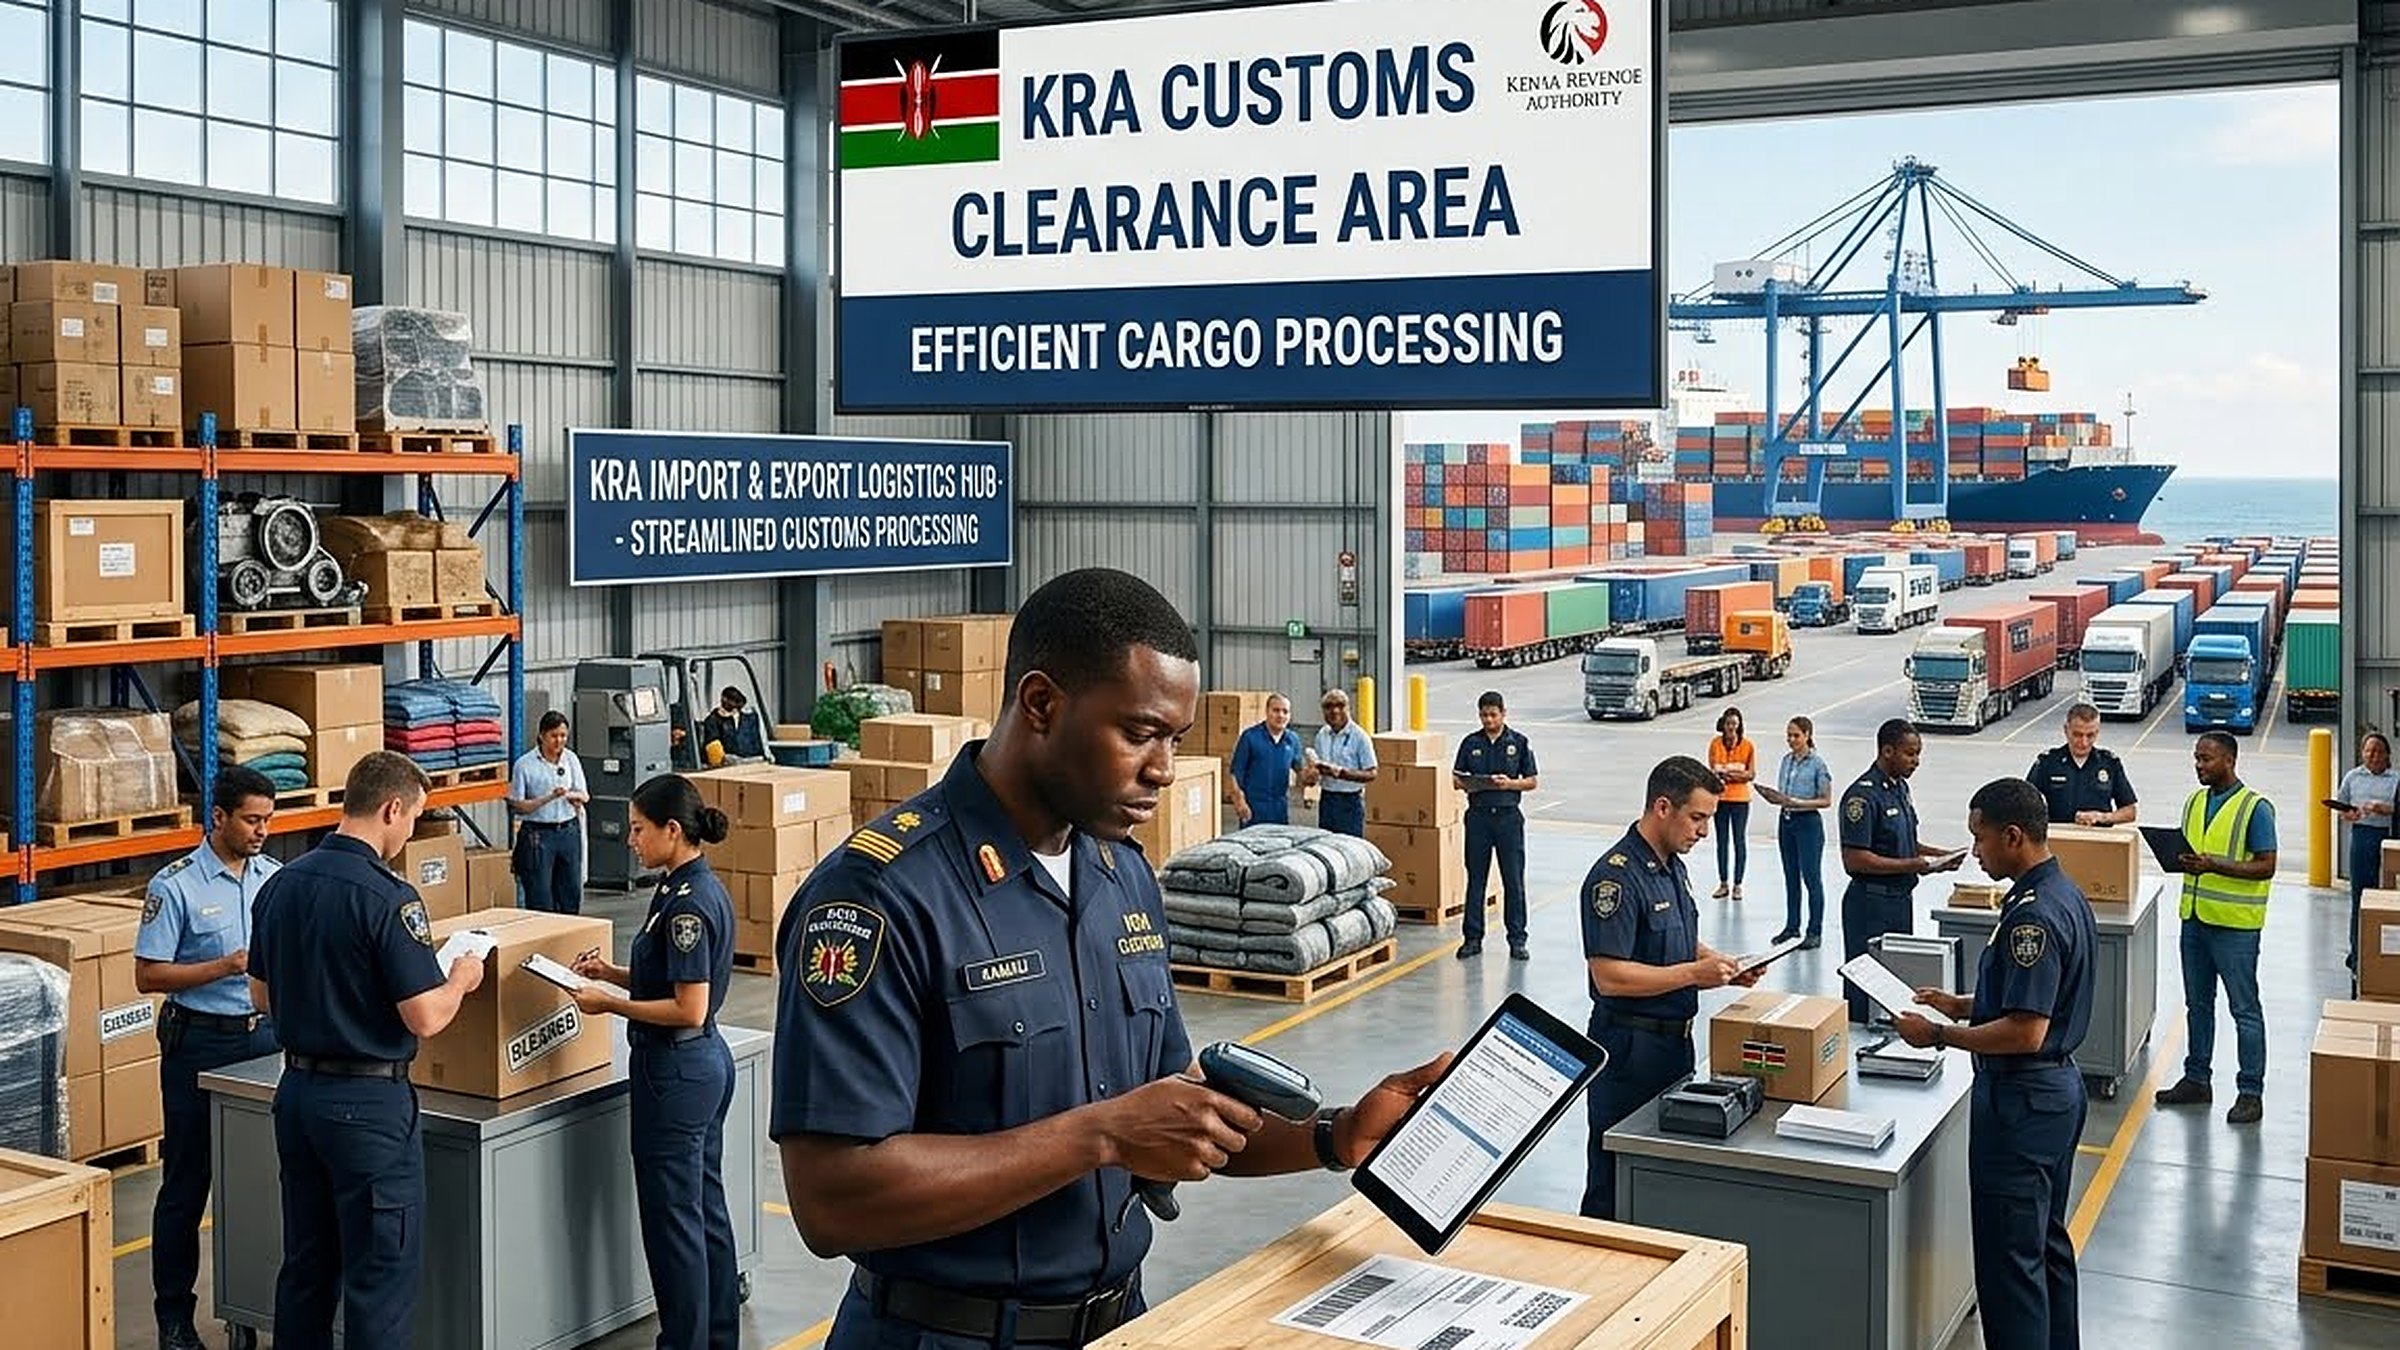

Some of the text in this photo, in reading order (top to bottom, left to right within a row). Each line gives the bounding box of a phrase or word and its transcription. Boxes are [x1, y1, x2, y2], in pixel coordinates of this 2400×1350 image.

[1023, 42, 1475, 140] KRA CUSTOMS
[953, 165, 1521, 259] CLEARANCE AREA
[912, 310, 1563, 372] EFFICIENT CARGO PROCESSING
[590, 458, 643, 501] KRA
[650, 459, 742, 501] IMPORT
[748, 460, 764, 500] &
[770, 461, 853, 499] EXPORT
[858, 463, 956, 499] LOGISTICS
[630, 517, 777, 556] STREAMLINED
[782, 515, 871, 551] CUSTOMS
[875, 513, 979, 547] PROCESSING
